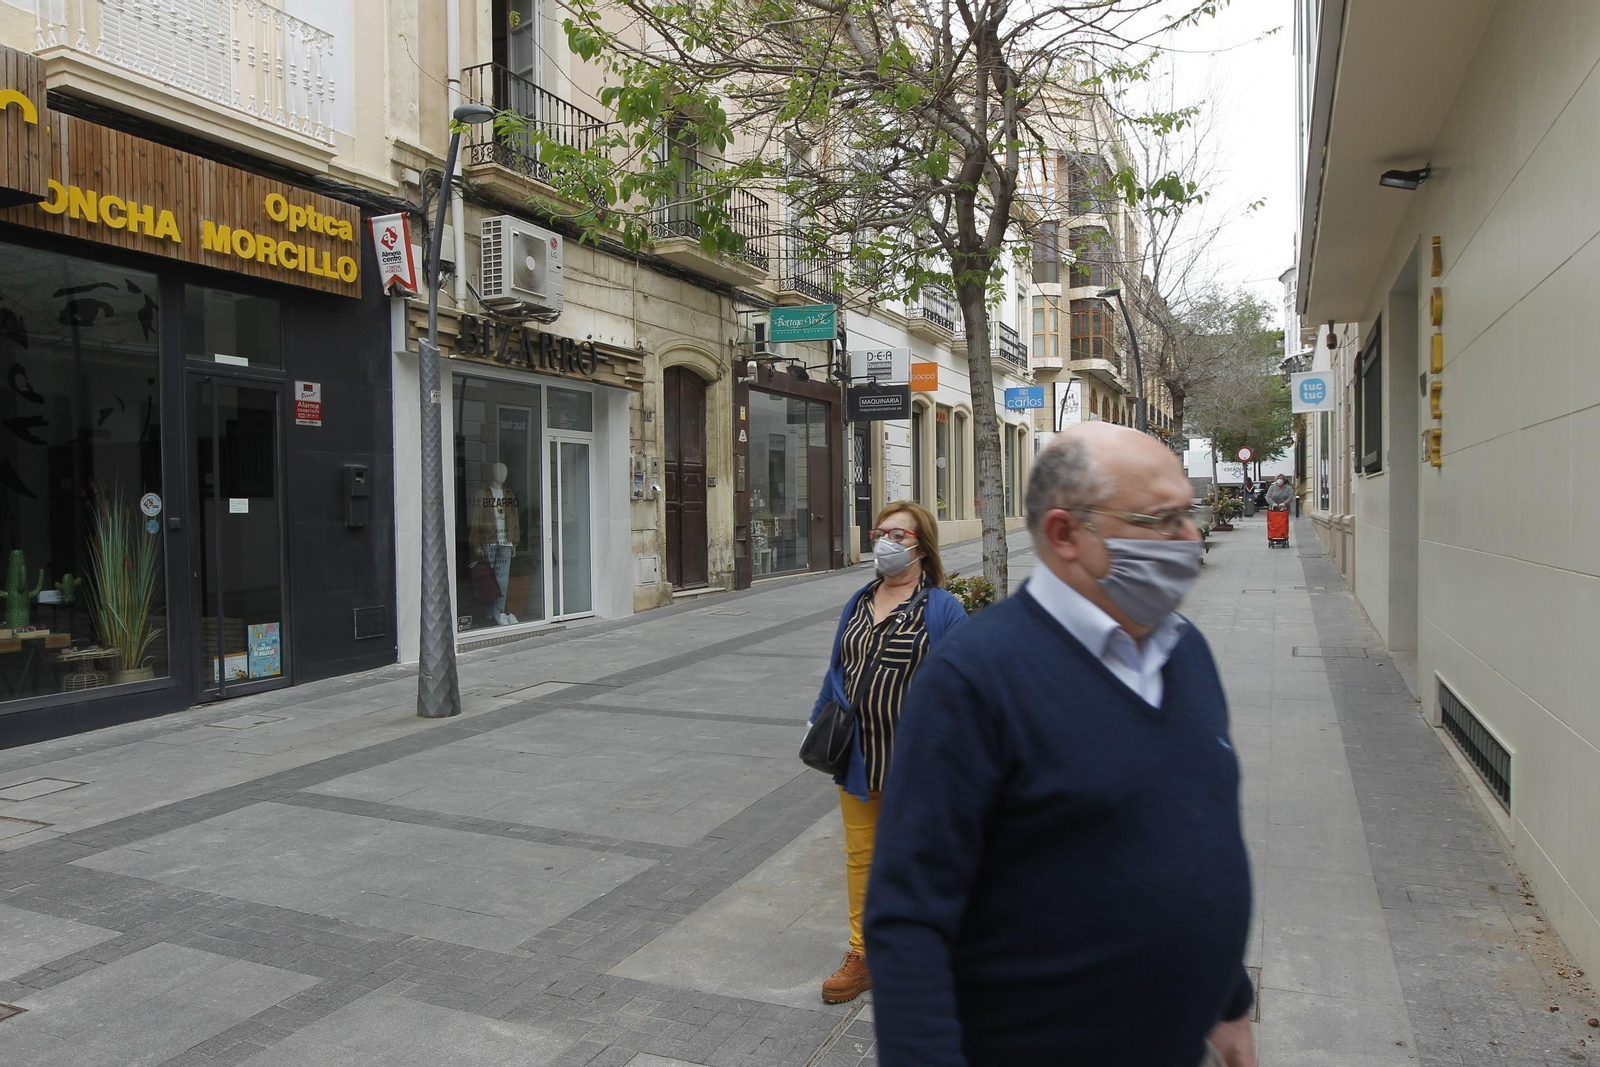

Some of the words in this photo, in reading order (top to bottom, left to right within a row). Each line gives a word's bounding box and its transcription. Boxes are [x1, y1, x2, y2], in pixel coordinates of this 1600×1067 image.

[202, 220, 358, 284] MORCILLO
[550, 251, 558, 259] LG
[460, 313, 598, 376] BIZARRO
[1303, 383, 1323, 391] tuc
[1303, 391, 1323, 400] tuc
[861, 397, 900, 405] MAQUINARIA
[1007, 397, 1042, 408] carlos
[482, 497, 520, 508] BIZARRO
